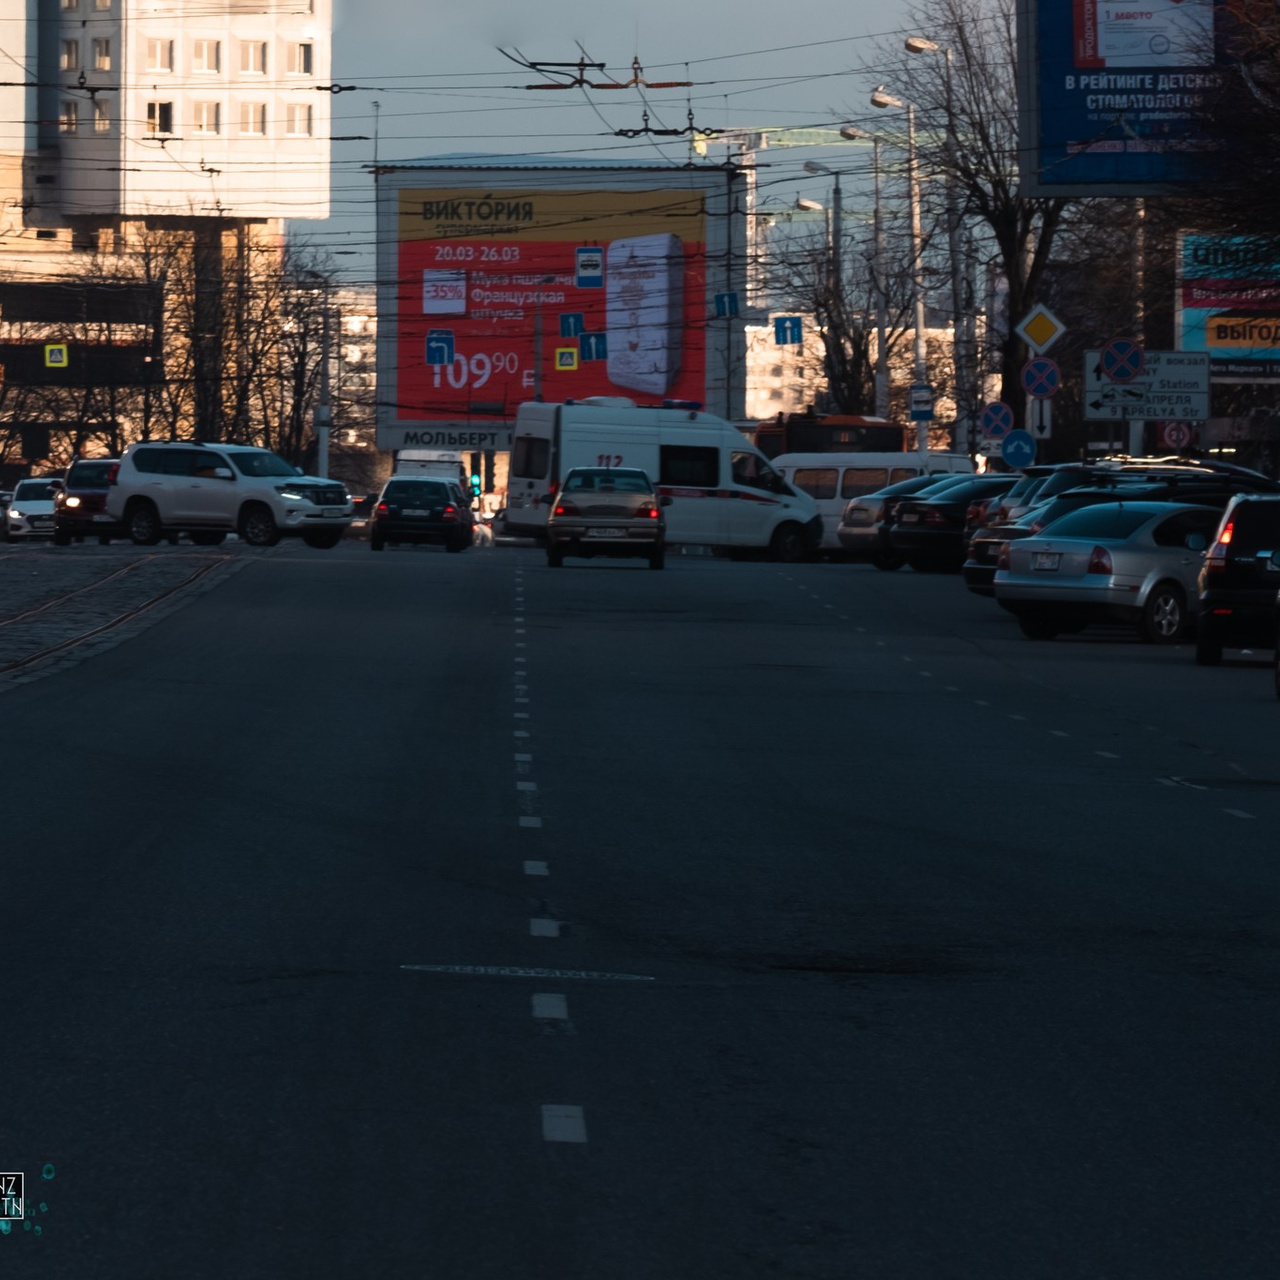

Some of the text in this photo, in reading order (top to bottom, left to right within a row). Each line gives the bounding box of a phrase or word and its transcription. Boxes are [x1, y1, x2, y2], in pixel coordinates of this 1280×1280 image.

[1105, 10, 1153, 21] 1 место
[1065, 76, 1075, 89] В
[1080, 72, 1153, 89] РЕЙТИНГЕ
[425, 284, 463, 299] -35%
[471, 288, 565, 310] Французская
[1166, 357, 1206, 366] вокзал
[1159, 379, 1200, 389] Station
[1182, 407, 1201, 417] Str
[403, 431, 499, 446] МОЛЬБЕРТ
[598, 454, 624, 467] 112
